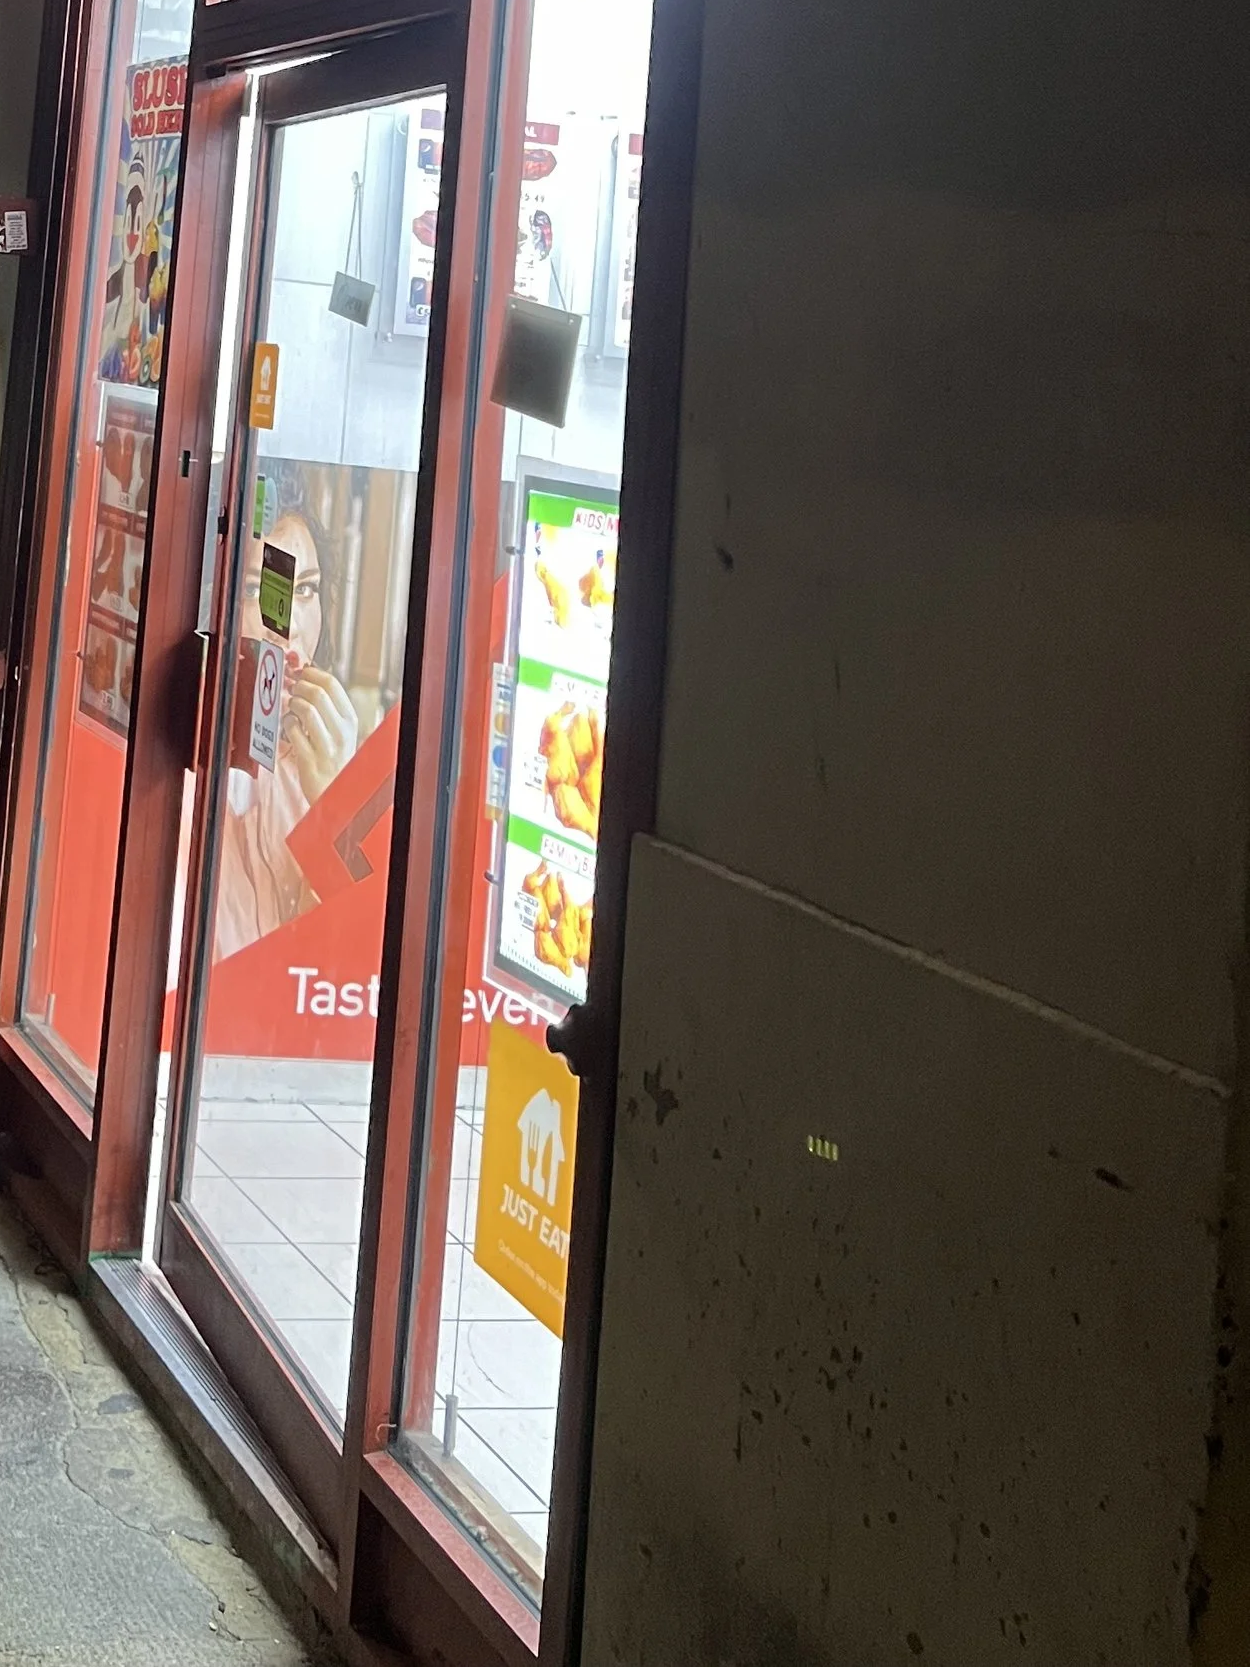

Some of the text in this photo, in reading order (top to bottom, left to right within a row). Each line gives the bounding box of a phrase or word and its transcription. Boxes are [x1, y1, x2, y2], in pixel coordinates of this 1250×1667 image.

[288, 967, 381, 1018] Tast
[500, 1183, 570, 1260] JUST EAT
